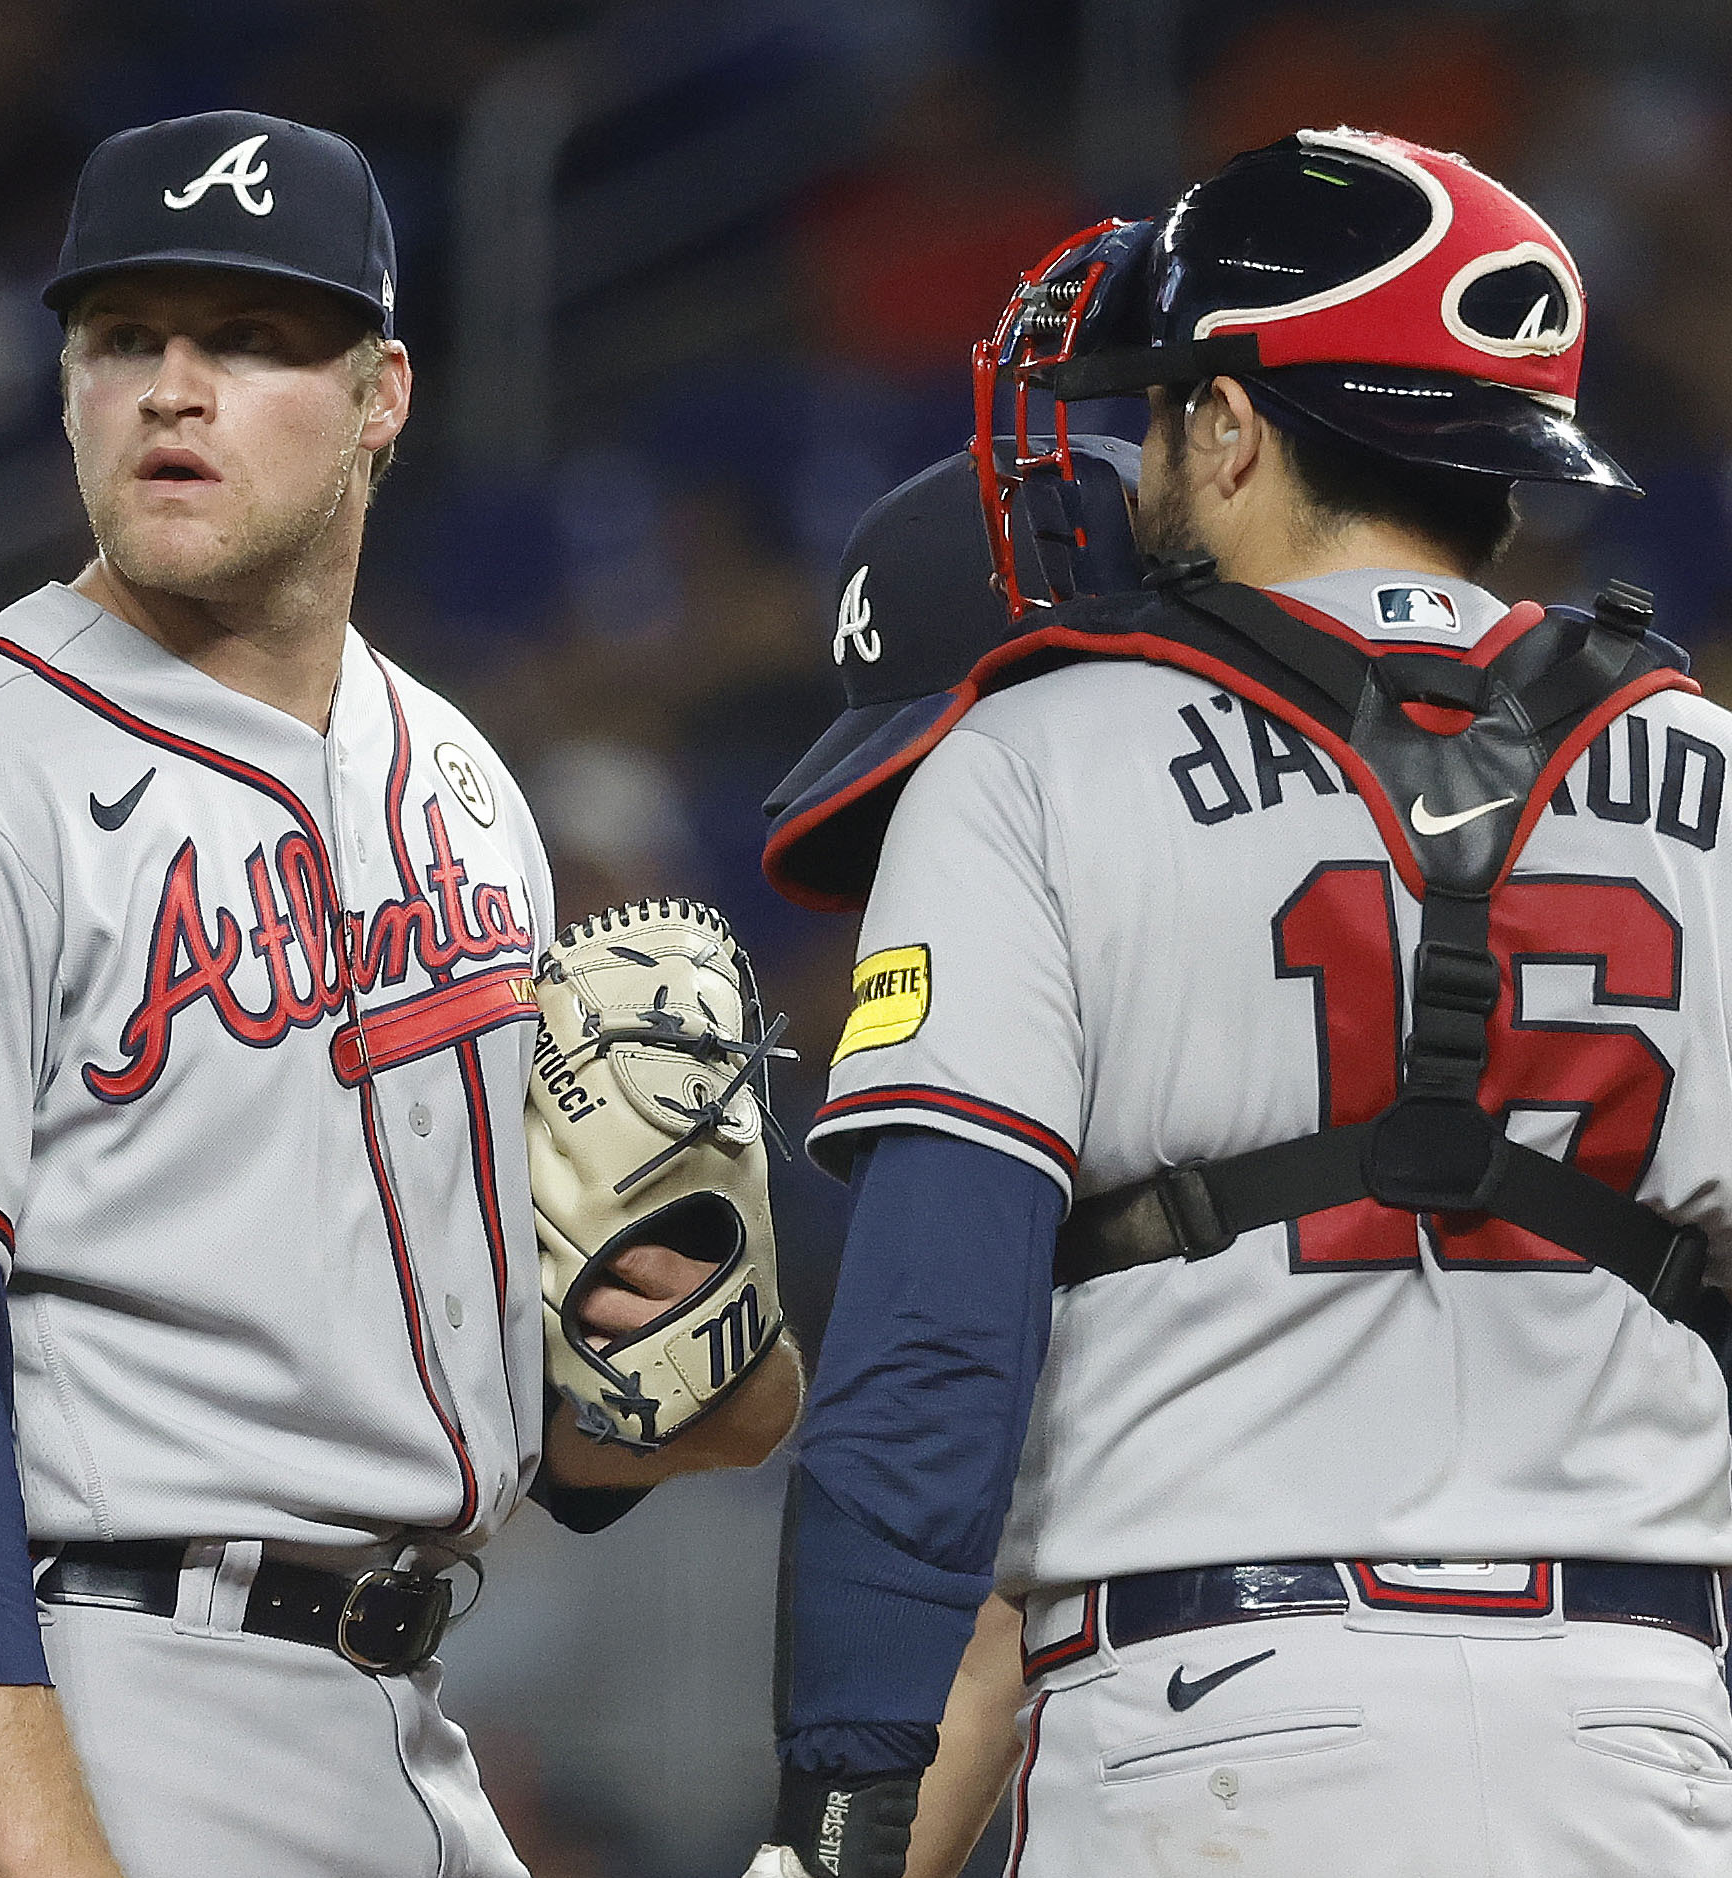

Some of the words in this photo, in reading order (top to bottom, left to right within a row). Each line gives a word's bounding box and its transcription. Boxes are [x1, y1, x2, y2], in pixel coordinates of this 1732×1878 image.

[164, 134, 274, 217] A
[833, 565, 882, 666] A
[448, 761, 486, 805] 21
[1169, 693, 1726, 852] d'AUD
[82, 793, 533, 1104] Atlanta
[856, 966, 921, 1006] KRETE
[818, 1791, 853, 1877] ALL-STAR
